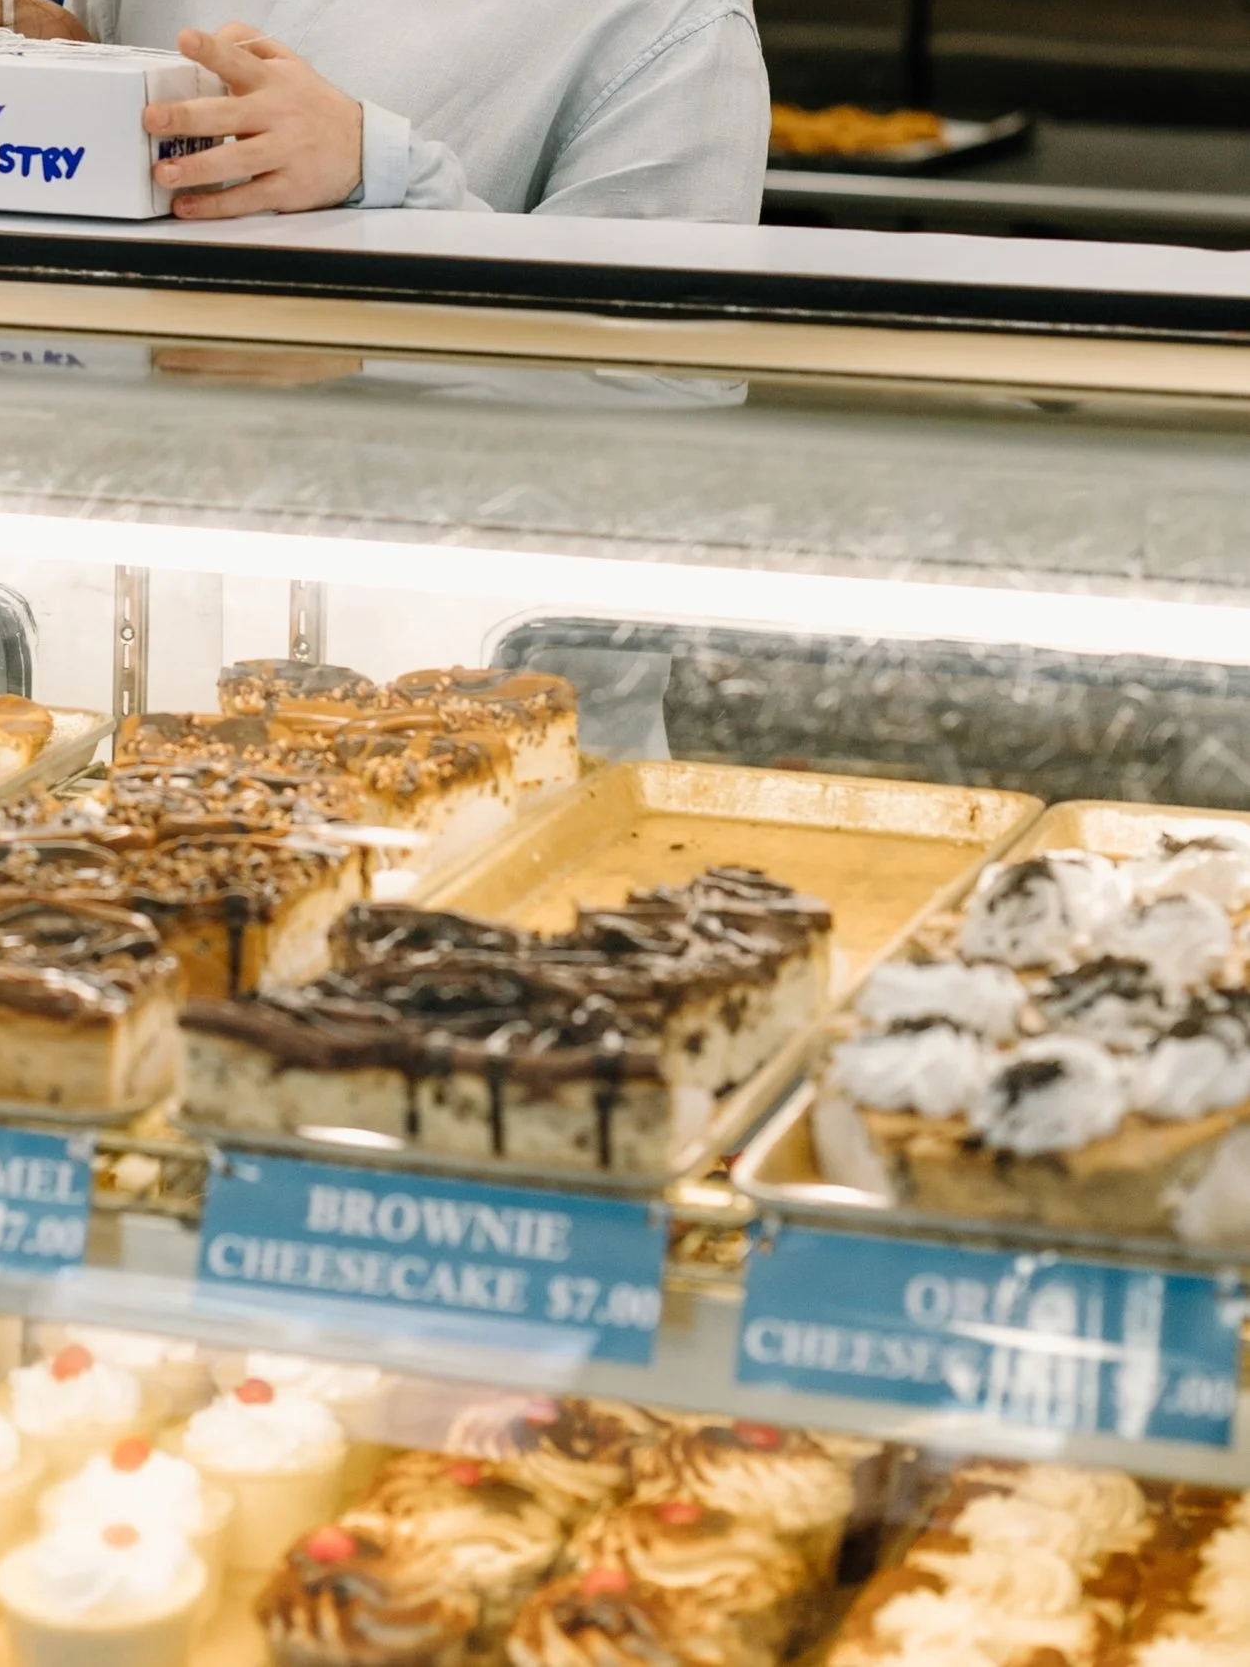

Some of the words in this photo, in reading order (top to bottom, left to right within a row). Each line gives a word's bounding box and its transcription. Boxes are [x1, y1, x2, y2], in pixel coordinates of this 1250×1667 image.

[306, 1184, 572, 1262] BROWNIE
[207, 1233, 532, 1314] CHEESECAKE
[547, 1276, 662, 1332] $7.00
